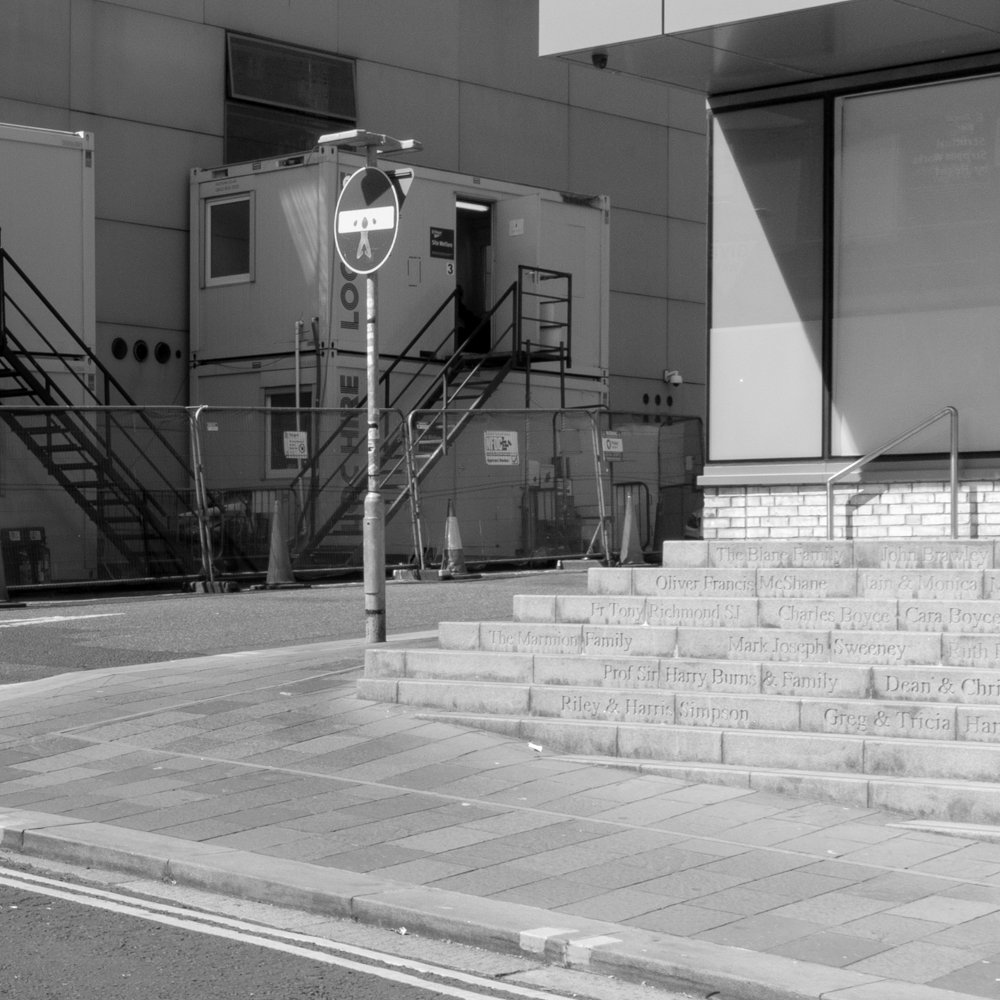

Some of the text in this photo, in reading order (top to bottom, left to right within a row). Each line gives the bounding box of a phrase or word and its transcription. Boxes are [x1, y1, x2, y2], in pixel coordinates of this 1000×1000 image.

[447, 264, 454, 274] 3
[717, 546, 745, 562] The
[792, 547, 847, 567] Family
[881, 546, 991, 568] John Brawley
[656, 575, 827, 592] Oliver Francis McShane
[898, 575, 913, 591] &
[919, 575, 977, 592] Monica
[590, 602, 605, 619] Fr
[606, 602, 644, 623] Tony
[648, 604, 721, 621] Richmond
[777, 605, 890, 627] Charles Boyce
[906, 606, 1000, 628] Cara Boyce
[488, 629, 634, 653] The Marmion Family
[727, 634, 907, 661] Mark Joseph Sweeney
[603, 664, 633, 682] Prof
[637, 665, 659, 682] Sir
[665, 667, 708, 688] Harry
[762, 670, 779, 687] &
[782, 670, 839, 693] Family
[885, 675, 931, 693] Dean
[938, 677, 955, 694] &
[560, 695, 750, 723] Riley & Harris Simpson
[823, 706, 867, 730] Greg
[873, 709, 891, 727] &
[896, 710, 951, 731] Tricia
